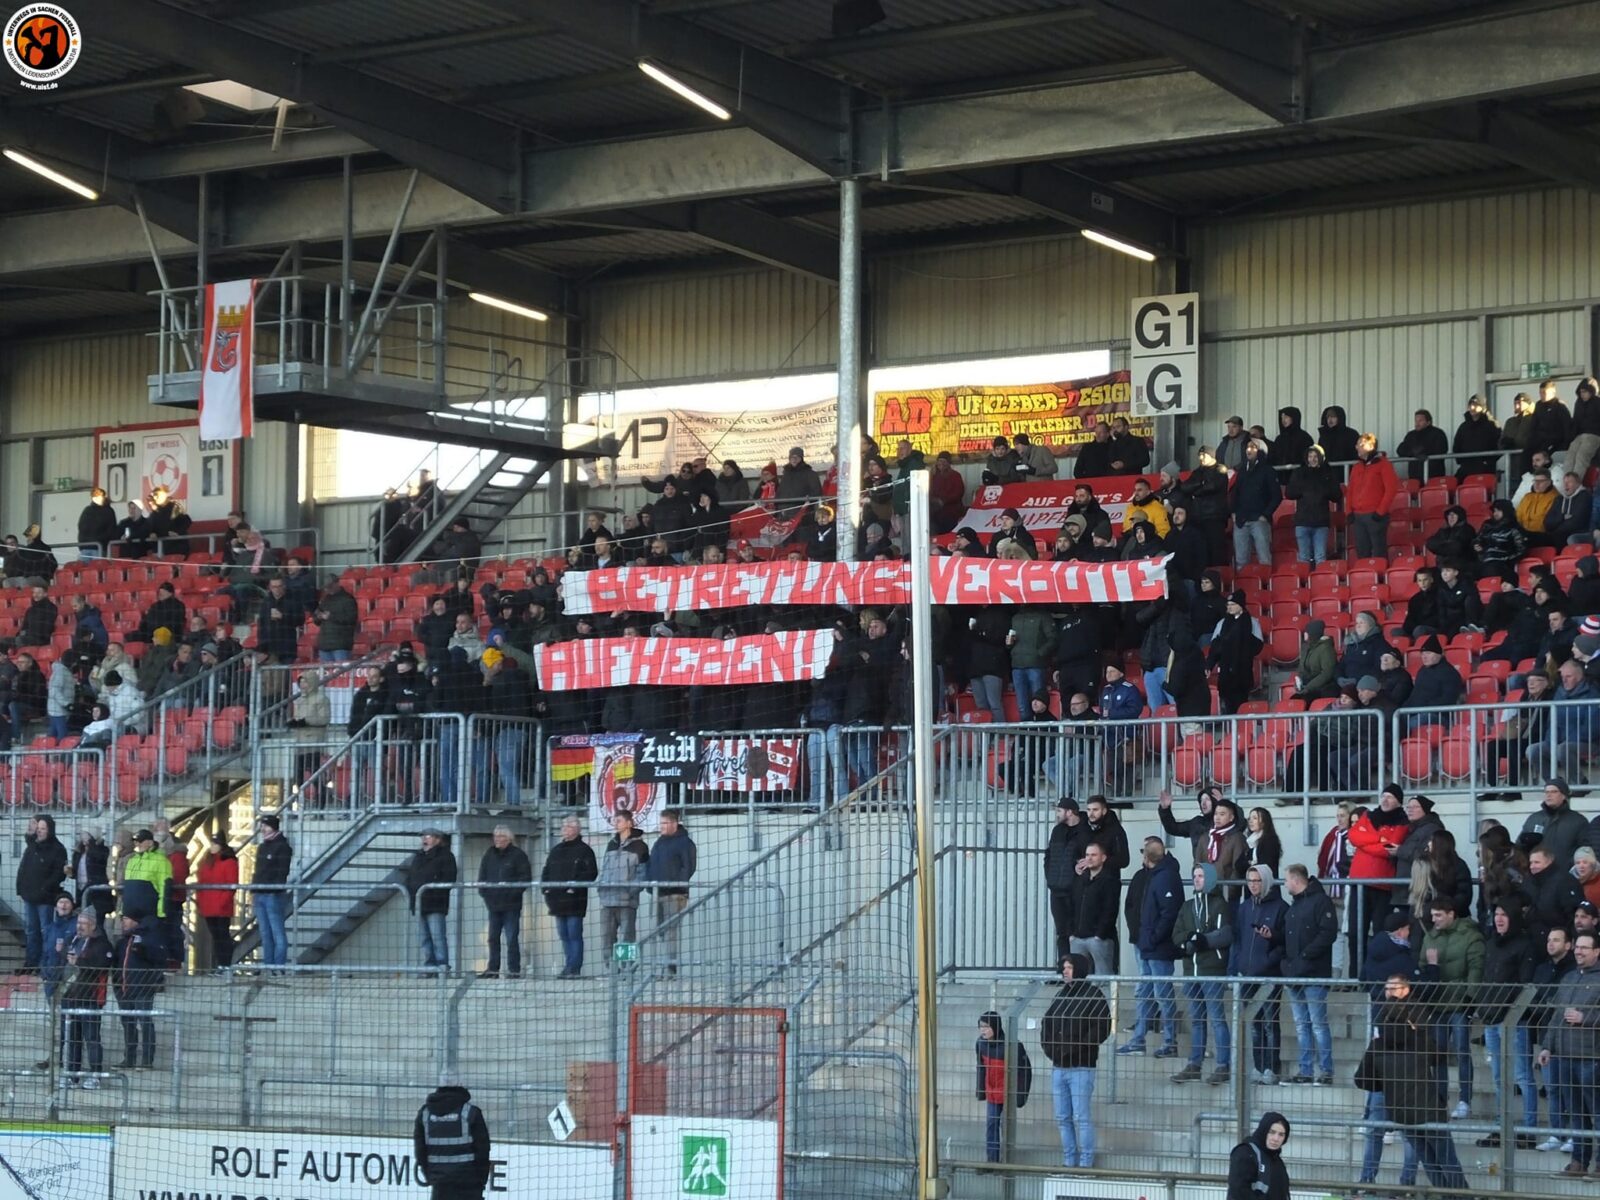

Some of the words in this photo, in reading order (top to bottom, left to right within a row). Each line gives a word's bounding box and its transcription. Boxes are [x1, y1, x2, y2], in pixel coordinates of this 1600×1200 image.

[1134, 301, 1195, 350] G1
[1146, 363, 1183, 412] G
[696, 417, 745, 425] PARTNER
[748, 415, 769, 425] FÜR
[880, 397, 932, 434] AD
[960, 422, 1000, 438] DEINE
[1003, 416, 1083, 435] AUFKLEBER
[101, 438, 135, 460] Heim
[109, 465, 125, 502] 0
[206, 457, 219, 496] 1
[1022, 496, 1057, 507] AUF
[541, 630, 817, 691] AUFHEBEN!
[554, 1108, 570, 1134] 1
[211, 1145, 290, 1179] ROLF
